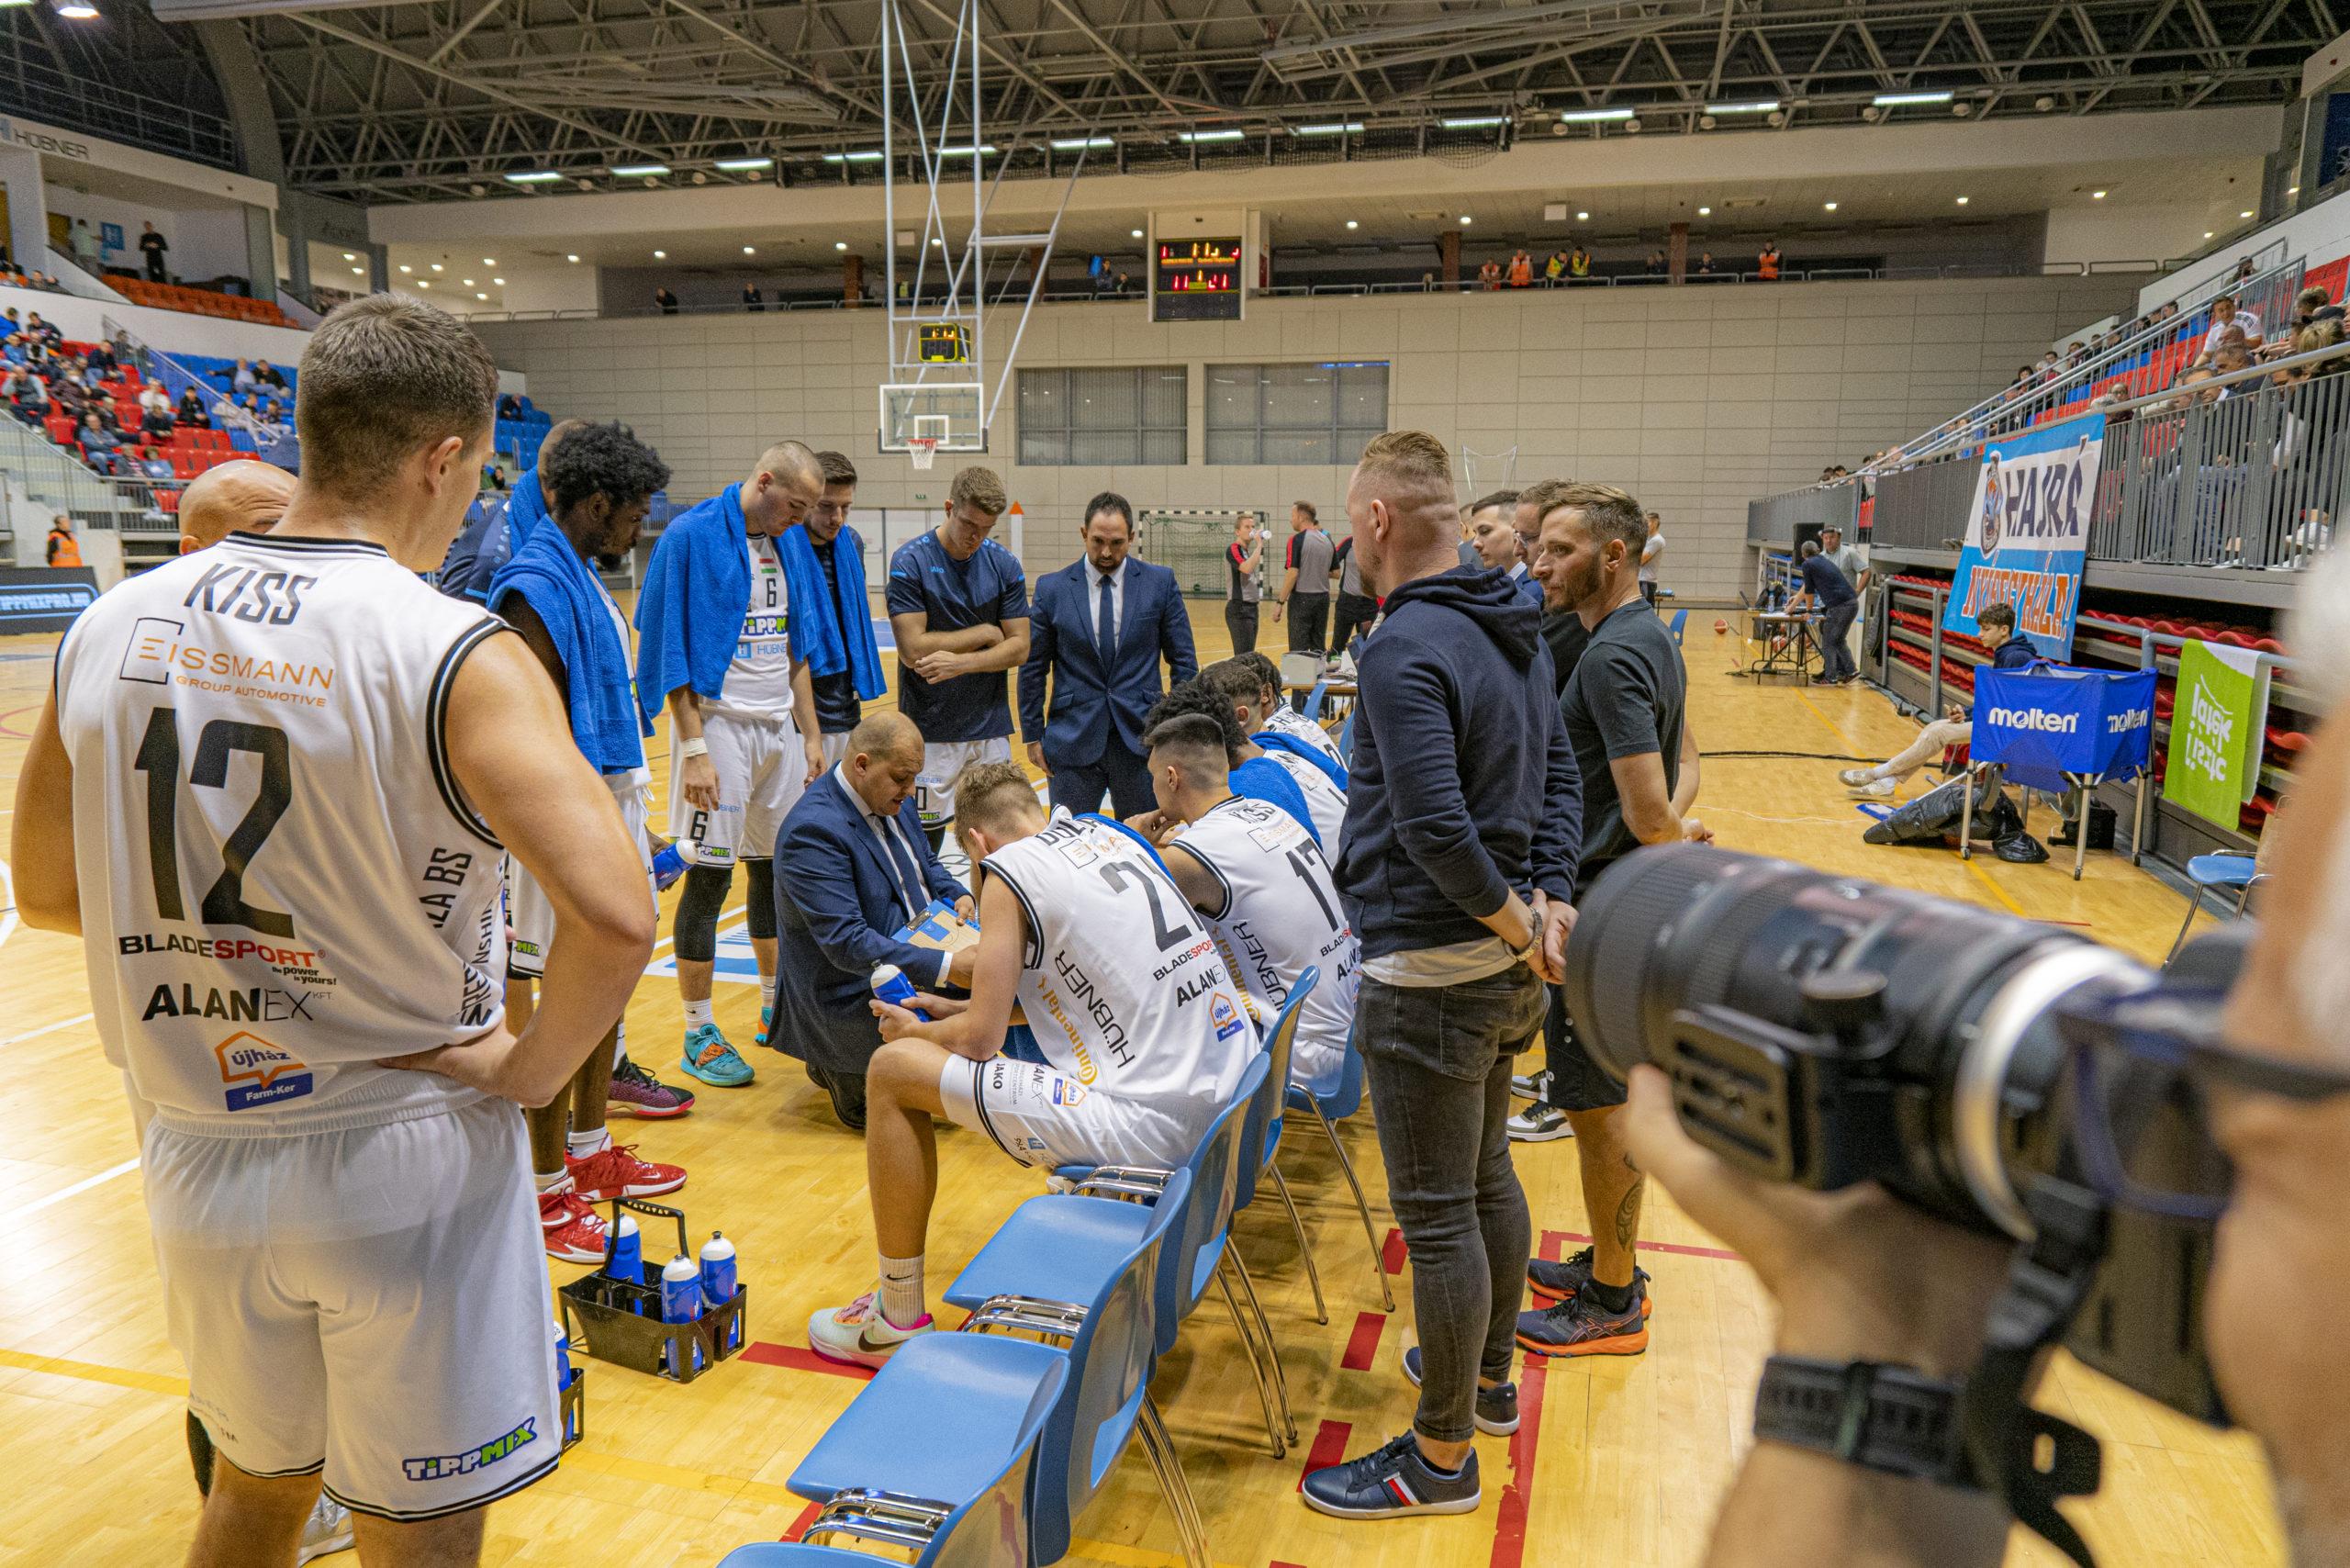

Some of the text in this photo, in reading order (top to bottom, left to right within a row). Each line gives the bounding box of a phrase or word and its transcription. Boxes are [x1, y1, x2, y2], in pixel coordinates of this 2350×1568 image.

[2005, 434, 2090, 537] HAJRÁ
[184, 563, 319, 625] KISS
[766, 577, 777, 608] 6
[139, 637, 334, 689] EISSMANN
[176, 676, 327, 708] GROUP AUTOMOTIVE
[1988, 707, 2079, 733] molten
[134, 707, 296, 940] 12
[690, 811, 709, 841] 6
[423, 847, 473, 886] BS
[283, 967, 319, 976] power
[301, 977, 337, 985] yours!
[142, 984, 313, 1022] ALANEX
[1055, 949, 1136, 1069] HÜBNER
[231, 1048, 291, 1068] újház
[246, 1085, 296, 1102] Farm-Ker
